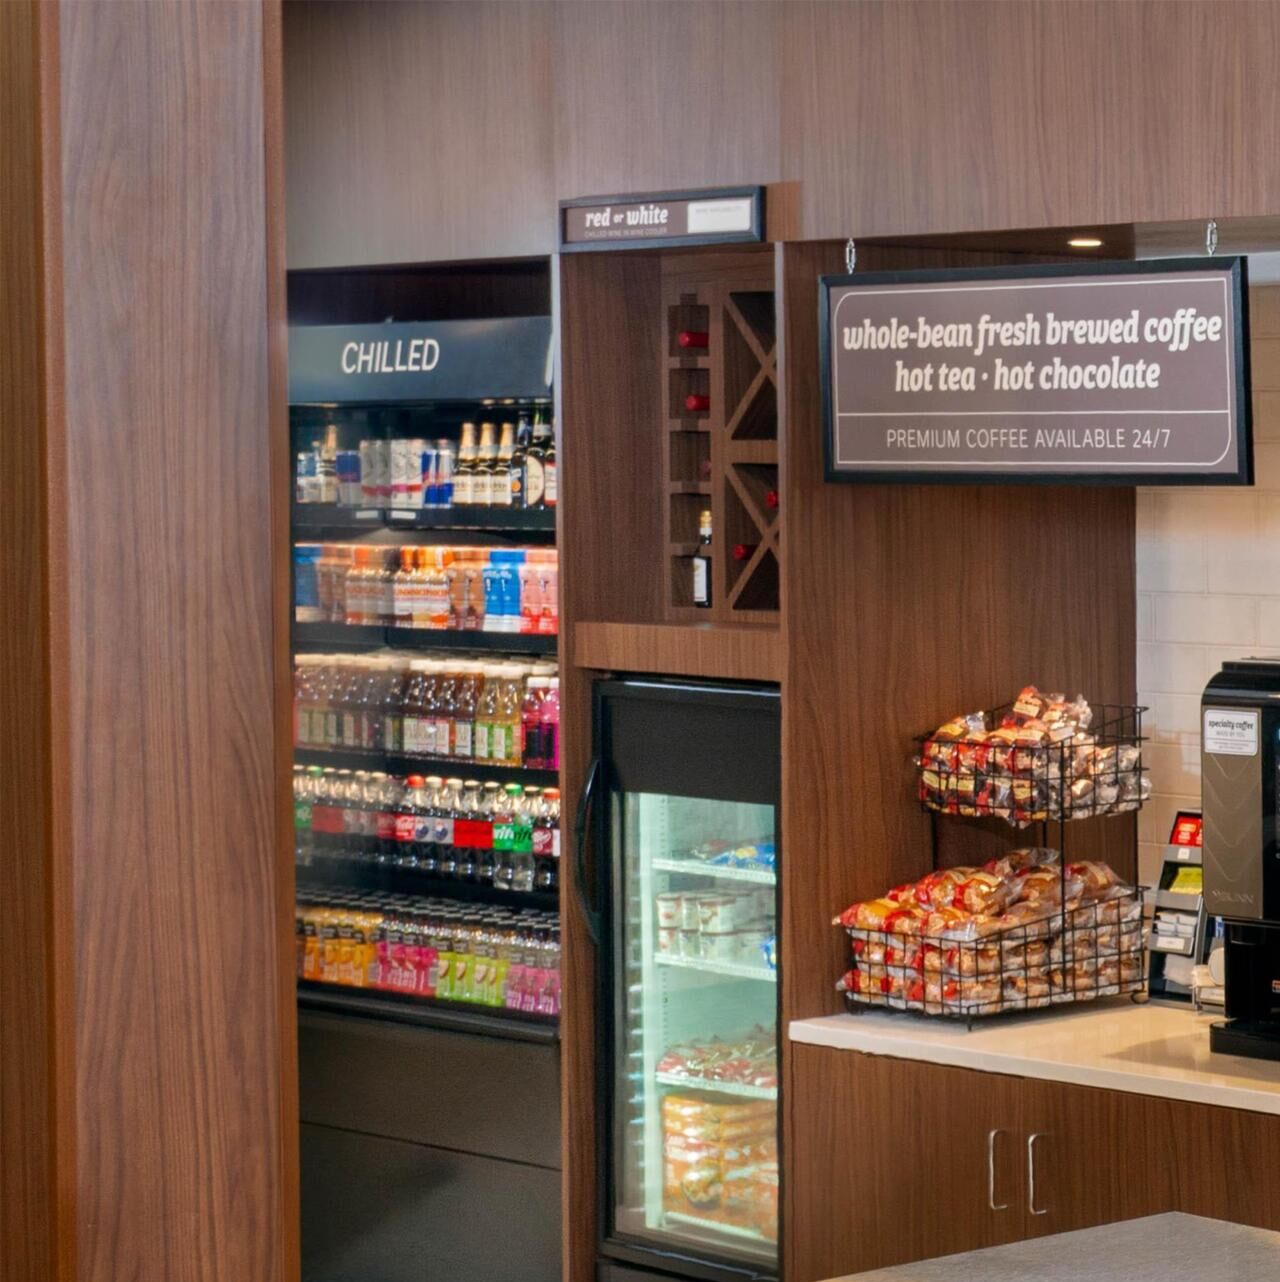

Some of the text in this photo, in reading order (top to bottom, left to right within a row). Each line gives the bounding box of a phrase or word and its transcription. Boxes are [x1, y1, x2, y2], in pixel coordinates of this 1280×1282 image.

[585, 204, 669, 227] red or white
[843, 308, 1222, 355] whole-bean fresh brewed coffee
[341, 338, 440, 374] CHILLED
[896, 356, 1161, 392] hot tea hot chocolate
[886, 428, 1171, 449] PREMIUM COFFEE AVAILABLE 24/7
